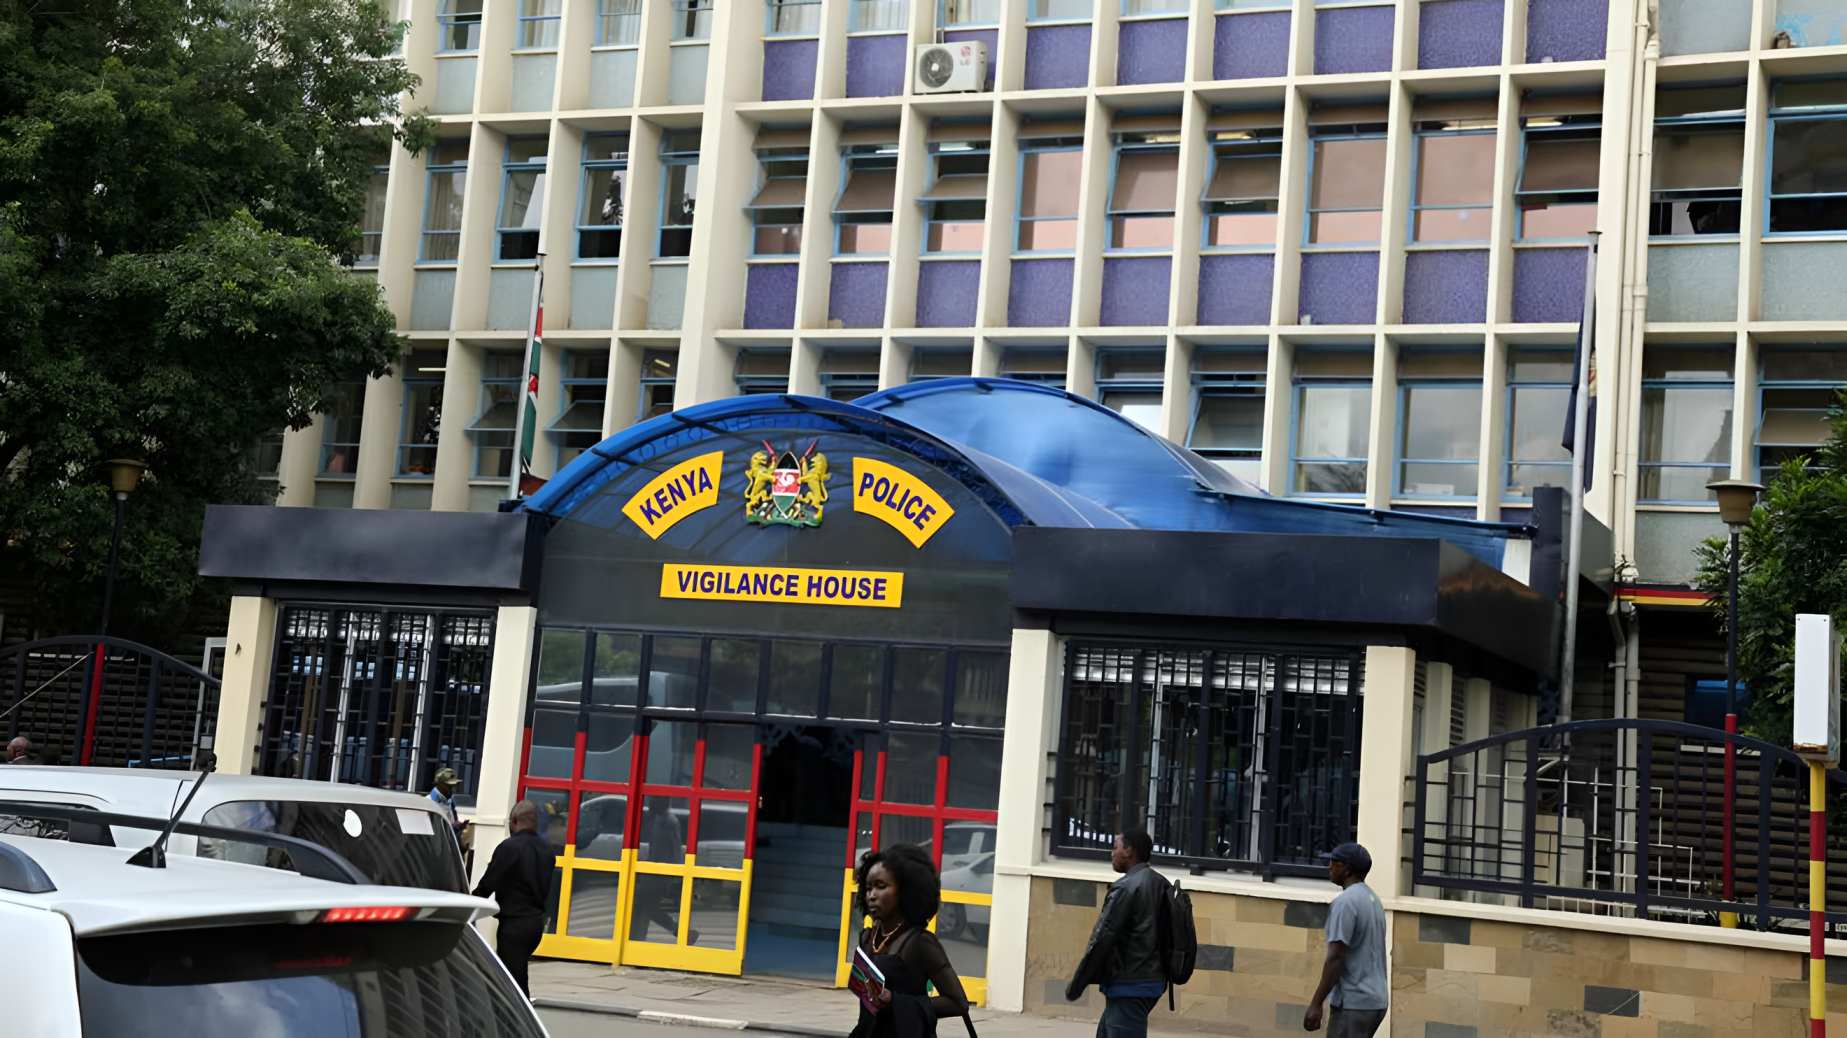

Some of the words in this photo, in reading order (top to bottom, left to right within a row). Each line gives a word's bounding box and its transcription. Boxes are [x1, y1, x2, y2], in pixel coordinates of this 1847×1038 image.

[639, 467, 713, 526] KENYA
[858, 472, 937, 530] POLICE
[677, 570, 799, 597] VIGILANCE
[807, 575, 887, 601] HOUSE
